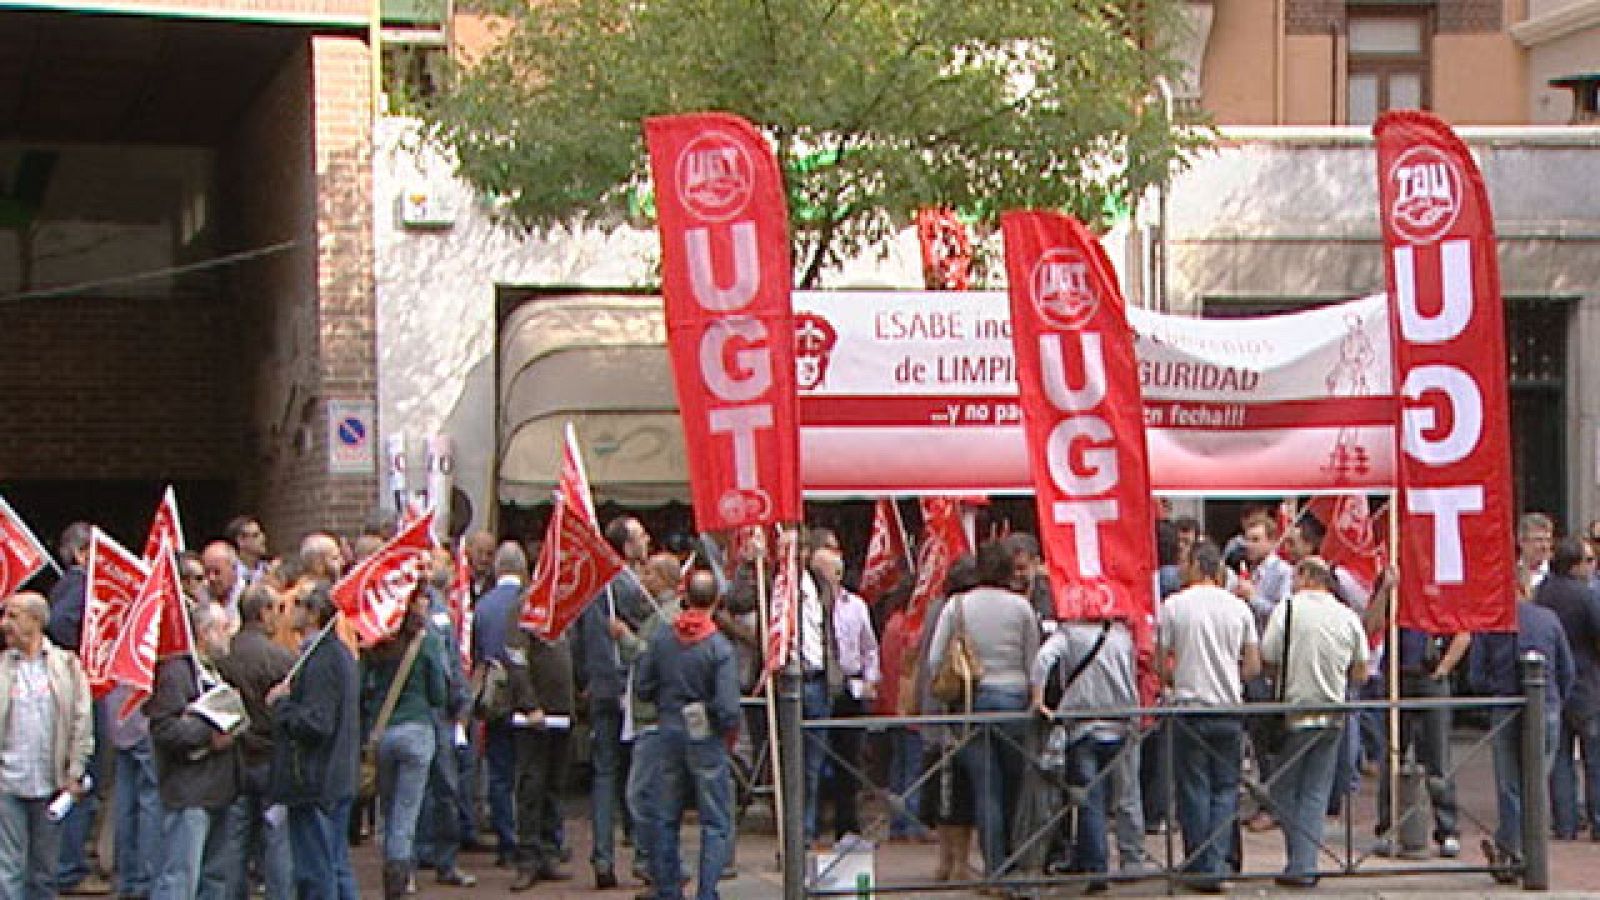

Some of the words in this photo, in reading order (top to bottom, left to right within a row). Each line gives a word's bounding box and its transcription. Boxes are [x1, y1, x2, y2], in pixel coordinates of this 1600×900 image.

[874, 311, 965, 340] ESABE
[684, 219, 774, 491] UGT
[895, 355, 926, 384] de
[964, 404, 990, 421] no
[1039, 331, 1121, 578] UGT
